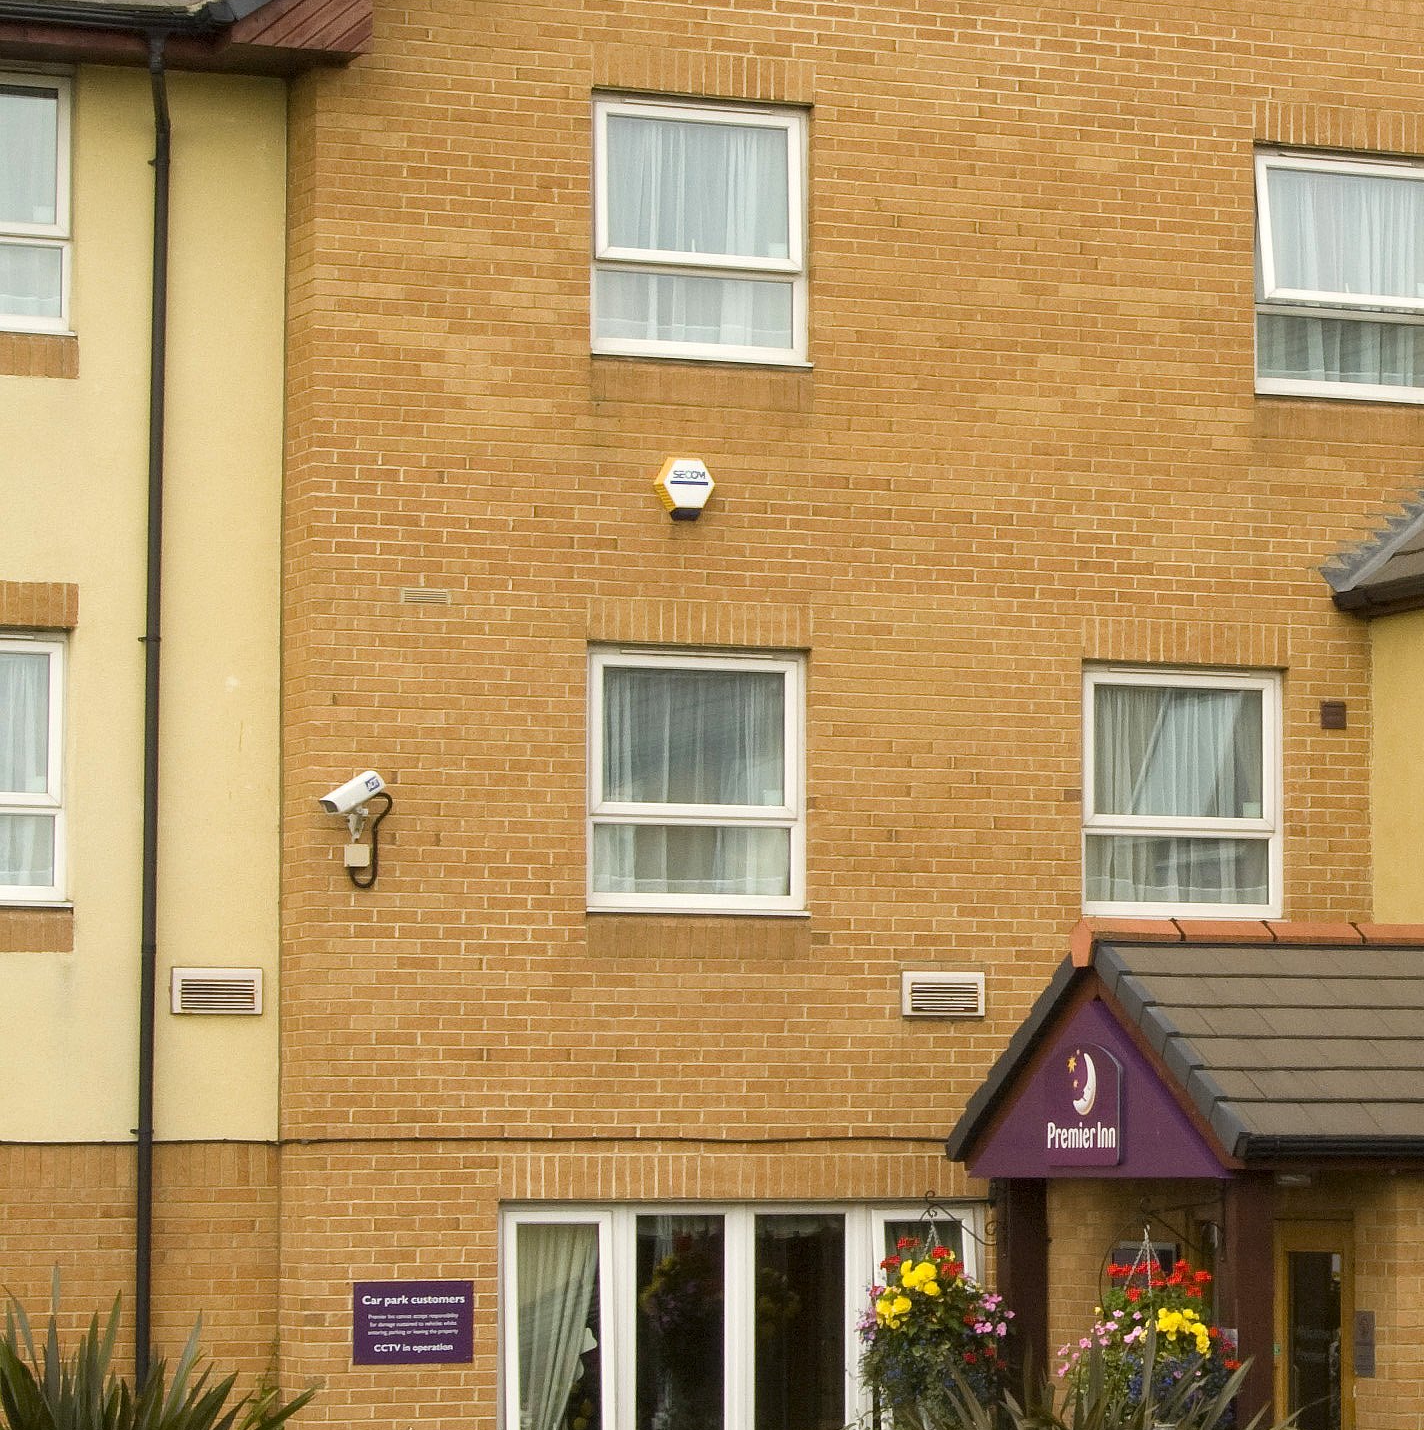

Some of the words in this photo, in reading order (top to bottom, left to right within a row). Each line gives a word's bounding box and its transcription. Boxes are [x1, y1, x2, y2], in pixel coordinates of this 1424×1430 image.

[673, 470, 706, 480] SECOM
[1047, 1121, 1096, 1149] Premier
[1097, 1121, 1116, 1148] Inn
[362, 1295, 382, 1305] Car
[384, 1295, 409, 1307] park
[411, 1295, 465, 1304] customers
[374, 1344, 401, 1352] CCTV
[402, 1344, 411, 1352] in
[412, 1343, 454, 1353] operation
